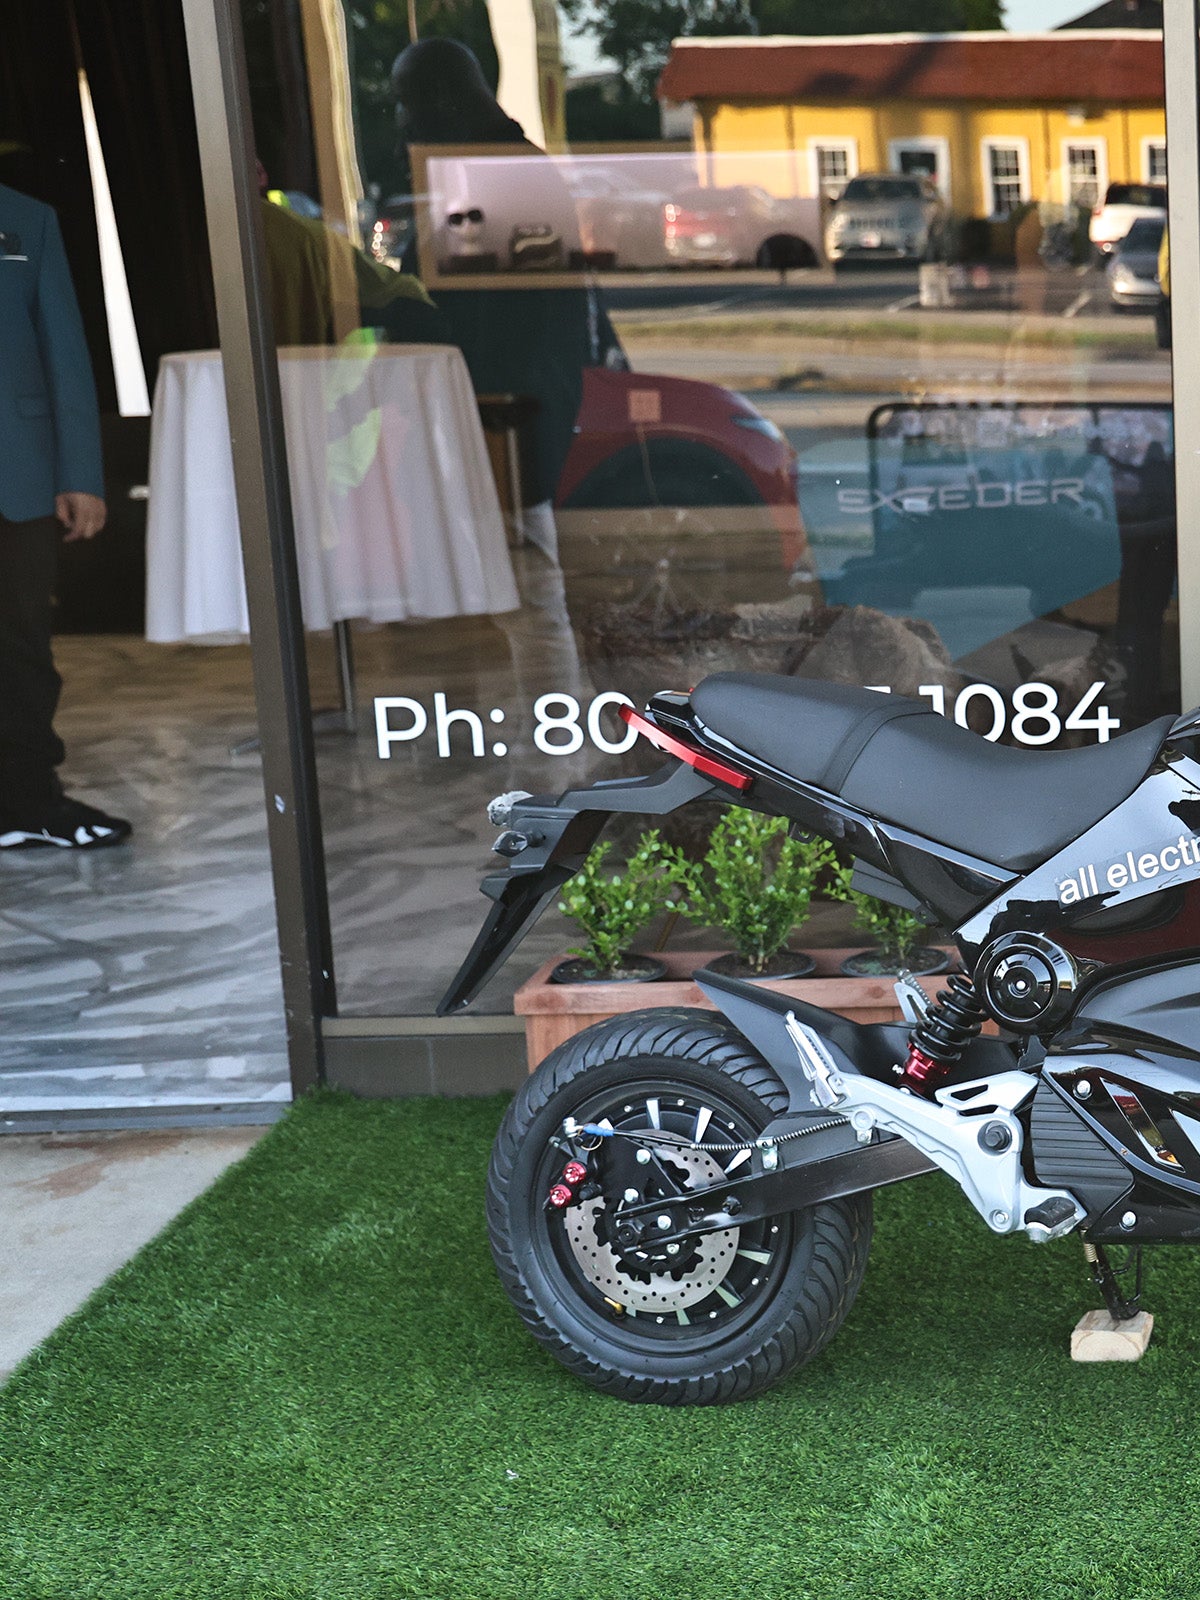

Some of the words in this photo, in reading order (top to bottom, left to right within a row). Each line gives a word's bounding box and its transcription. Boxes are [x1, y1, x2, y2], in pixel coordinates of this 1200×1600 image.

[374, 692, 508, 759] Ph:
[533, 691, 670, 755] 80
[1058, 866, 1099, 904] all
